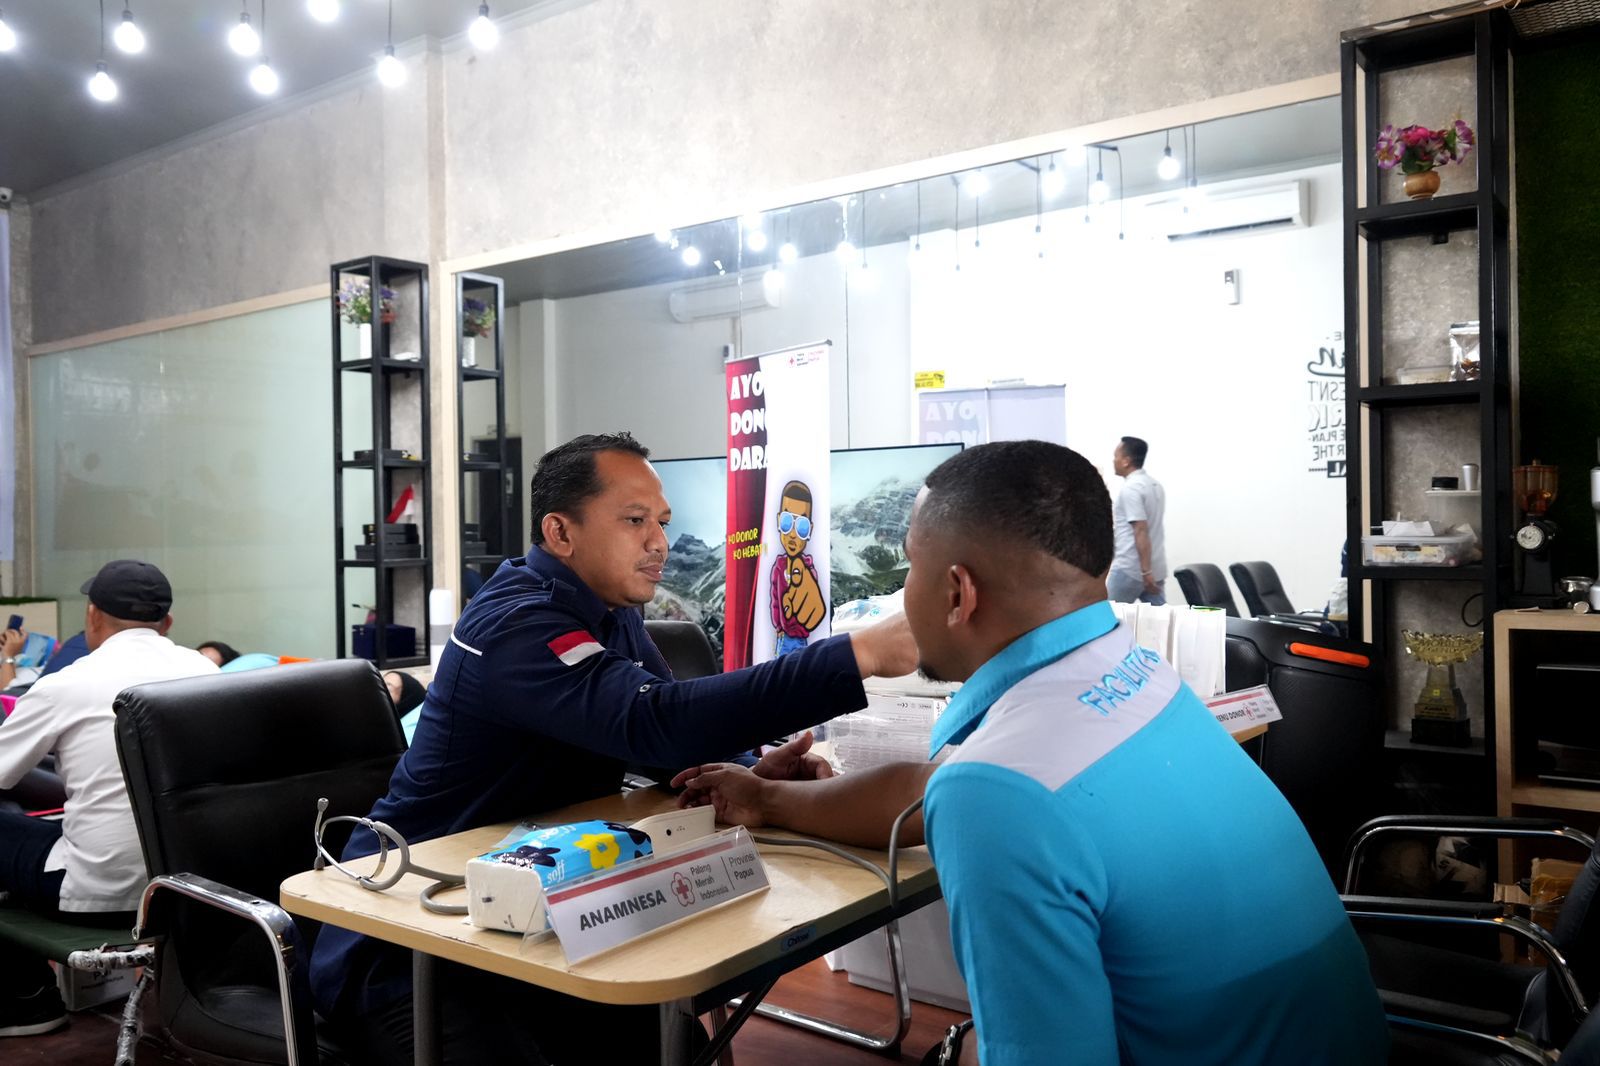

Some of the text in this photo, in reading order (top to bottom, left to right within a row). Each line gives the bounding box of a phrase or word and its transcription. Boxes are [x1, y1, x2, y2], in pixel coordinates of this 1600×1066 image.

[730, 371, 764, 400] AYO
[926, 400, 977, 421] AYO
[730, 408, 767, 436] DON
[735, 527, 759, 543] DONOR
[728, 853, 756, 867] Provinsi
[690, 863, 712, 876] Palang
[734, 868, 755, 881] Papua
[694, 875, 715, 888] Merah
[701, 885, 729, 900] Indonesia
[580, 889, 667, 931] ANAMNESA
